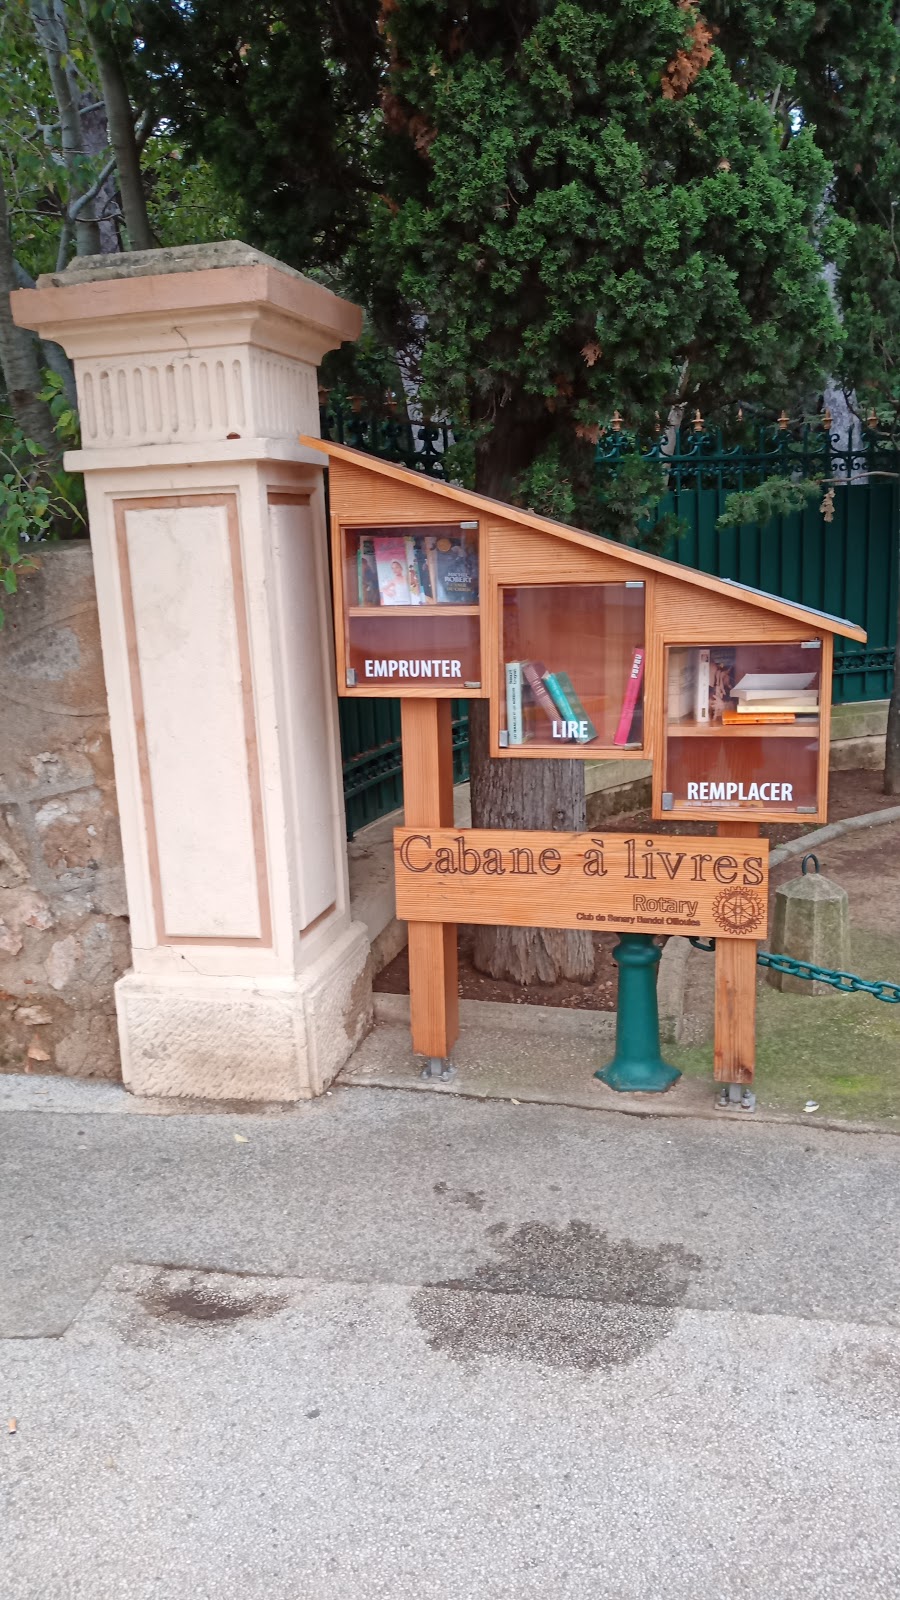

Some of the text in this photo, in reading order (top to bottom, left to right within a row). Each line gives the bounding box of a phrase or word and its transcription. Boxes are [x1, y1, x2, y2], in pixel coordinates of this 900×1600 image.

[365, 660, 461, 678] EMPRUNTER
[552, 720, 589, 738] LIRE
[687, 782, 793, 801] REMPLACER
[400, 834, 764, 886] Cabane à livres
[632, 894, 699, 917] Rotary
[576, 912, 594, 921] Club
[595, 914, 606, 922] de
[636, 916, 665, 925] Bandol
